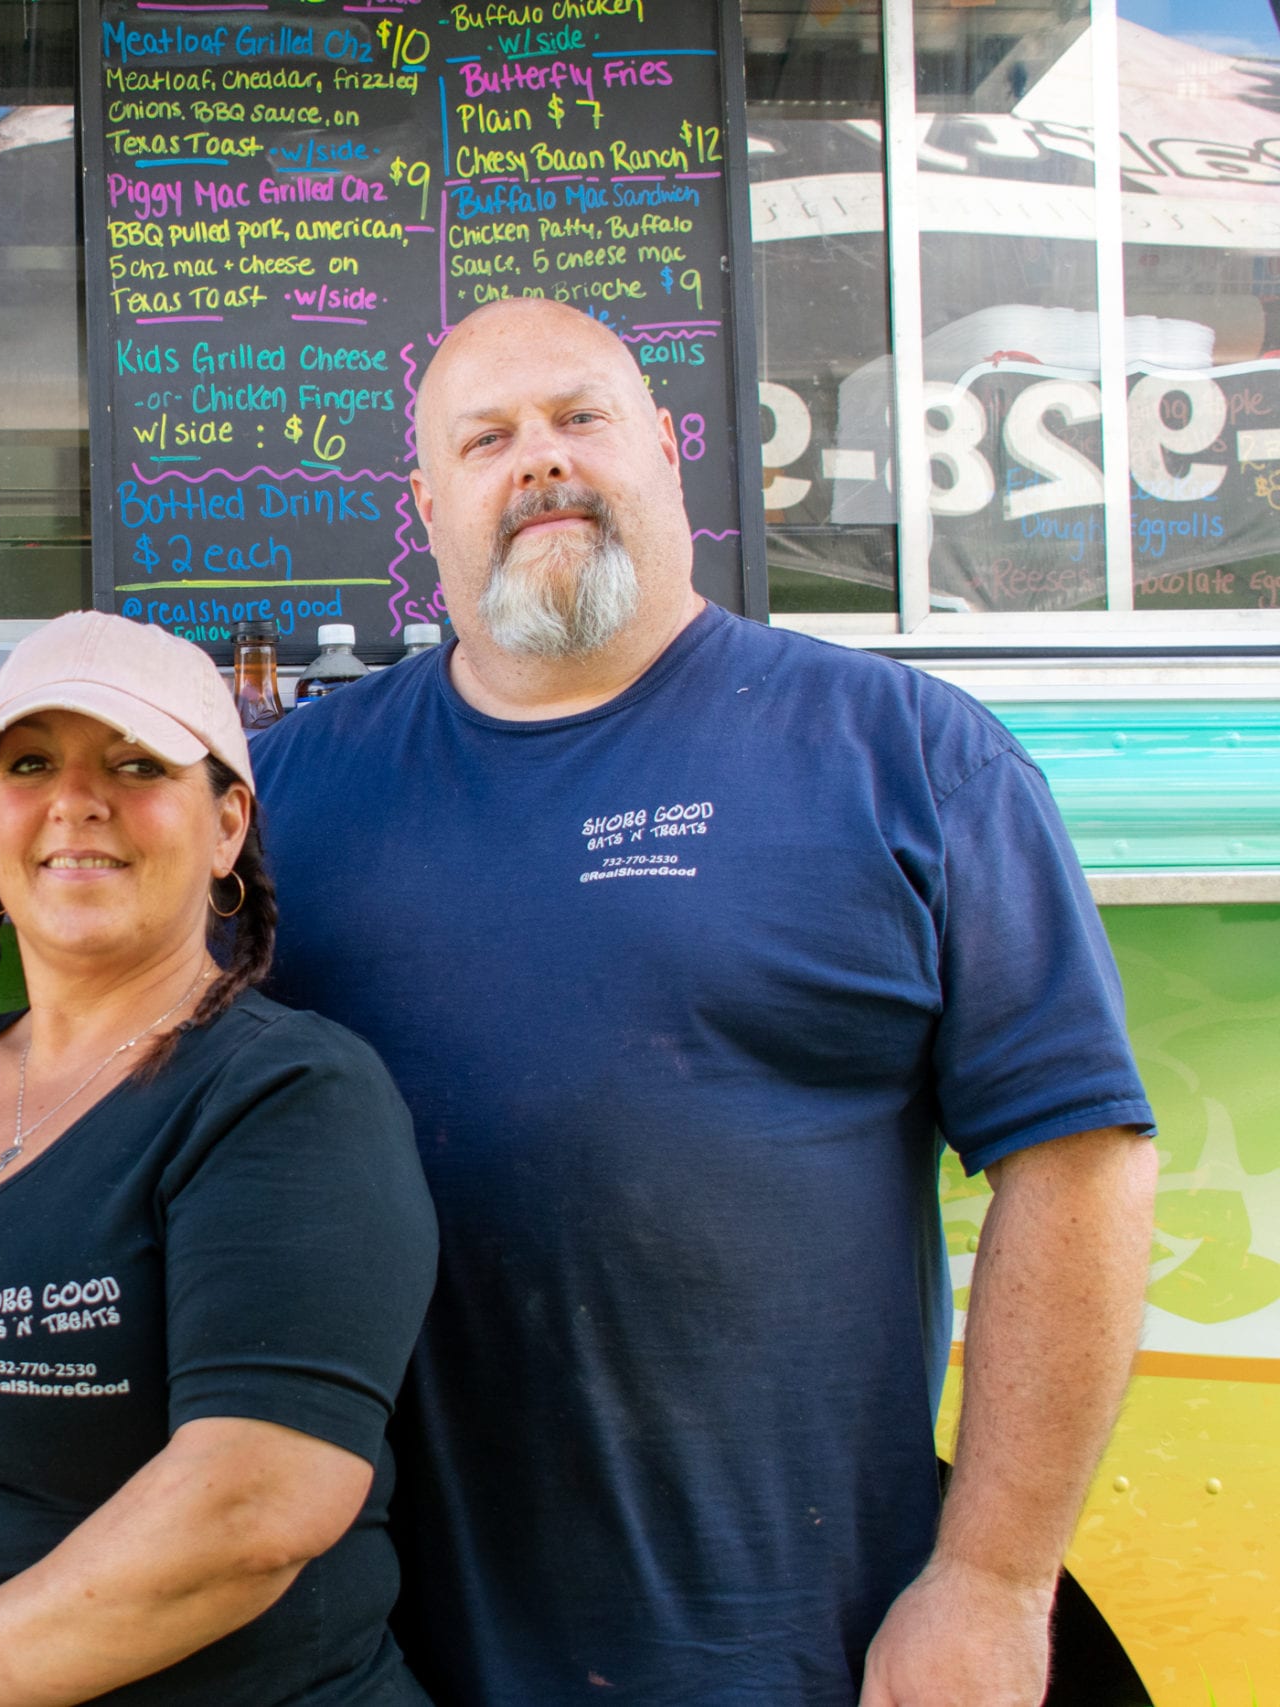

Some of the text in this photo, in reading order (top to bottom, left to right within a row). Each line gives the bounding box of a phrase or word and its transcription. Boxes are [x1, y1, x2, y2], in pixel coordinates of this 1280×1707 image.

[451, 3, 543, 31] Buffalo
[102, 22, 228, 63] Meatloaf
[235, 26, 313, 57] Grilled
[376, 19, 431, 68] $10
[459, 61, 673, 100] Butterfly Fries
[190, 100, 246, 123] BBQ
[333, 110, 360, 127] on
[456, 103, 532, 134] Plain
[106, 129, 180, 157] Texas
[183, 131, 264, 158] Toast
[679, 119, 723, 163] $12
[456, 140, 688, 181] Cheesy Bacon Ranch
[108, 173, 182, 220] Piggy
[194, 180, 251, 213] Mac
[259, 176, 334, 205] Grilled
[388, 156, 431, 221] $9
[450, 183, 699, 220] Buffalo Mac Sandwich
[108, 221, 164, 248] BBQ
[168, 218, 231, 247] pulled
[449, 222, 530, 249] Chicken
[605, 213, 693, 239] Buffalo
[173, 258, 219, 278] mac
[328, 256, 358, 276] on
[533, 248, 549, 273] 5
[638, 246, 686, 263] mac
[109, 287, 182, 314] Texas
[189, 285, 267, 309] Toast
[522, 286, 544, 299] on
[551, 278, 647, 303] Brioche
[117, 339, 389, 375] Kids Grilled Cheese
[192, 383, 286, 413] Chicken
[298, 384, 395, 425] Fingers
[117, 480, 381, 528] Bottled Drinks
[204, 536, 292, 581] each
[654, 802, 714, 822] GOOD
[580, 867, 697, 882] @RealShoreGood
[602, 855, 678, 867] 732-770-2530
[42, 1276, 120, 1309] GOOD
